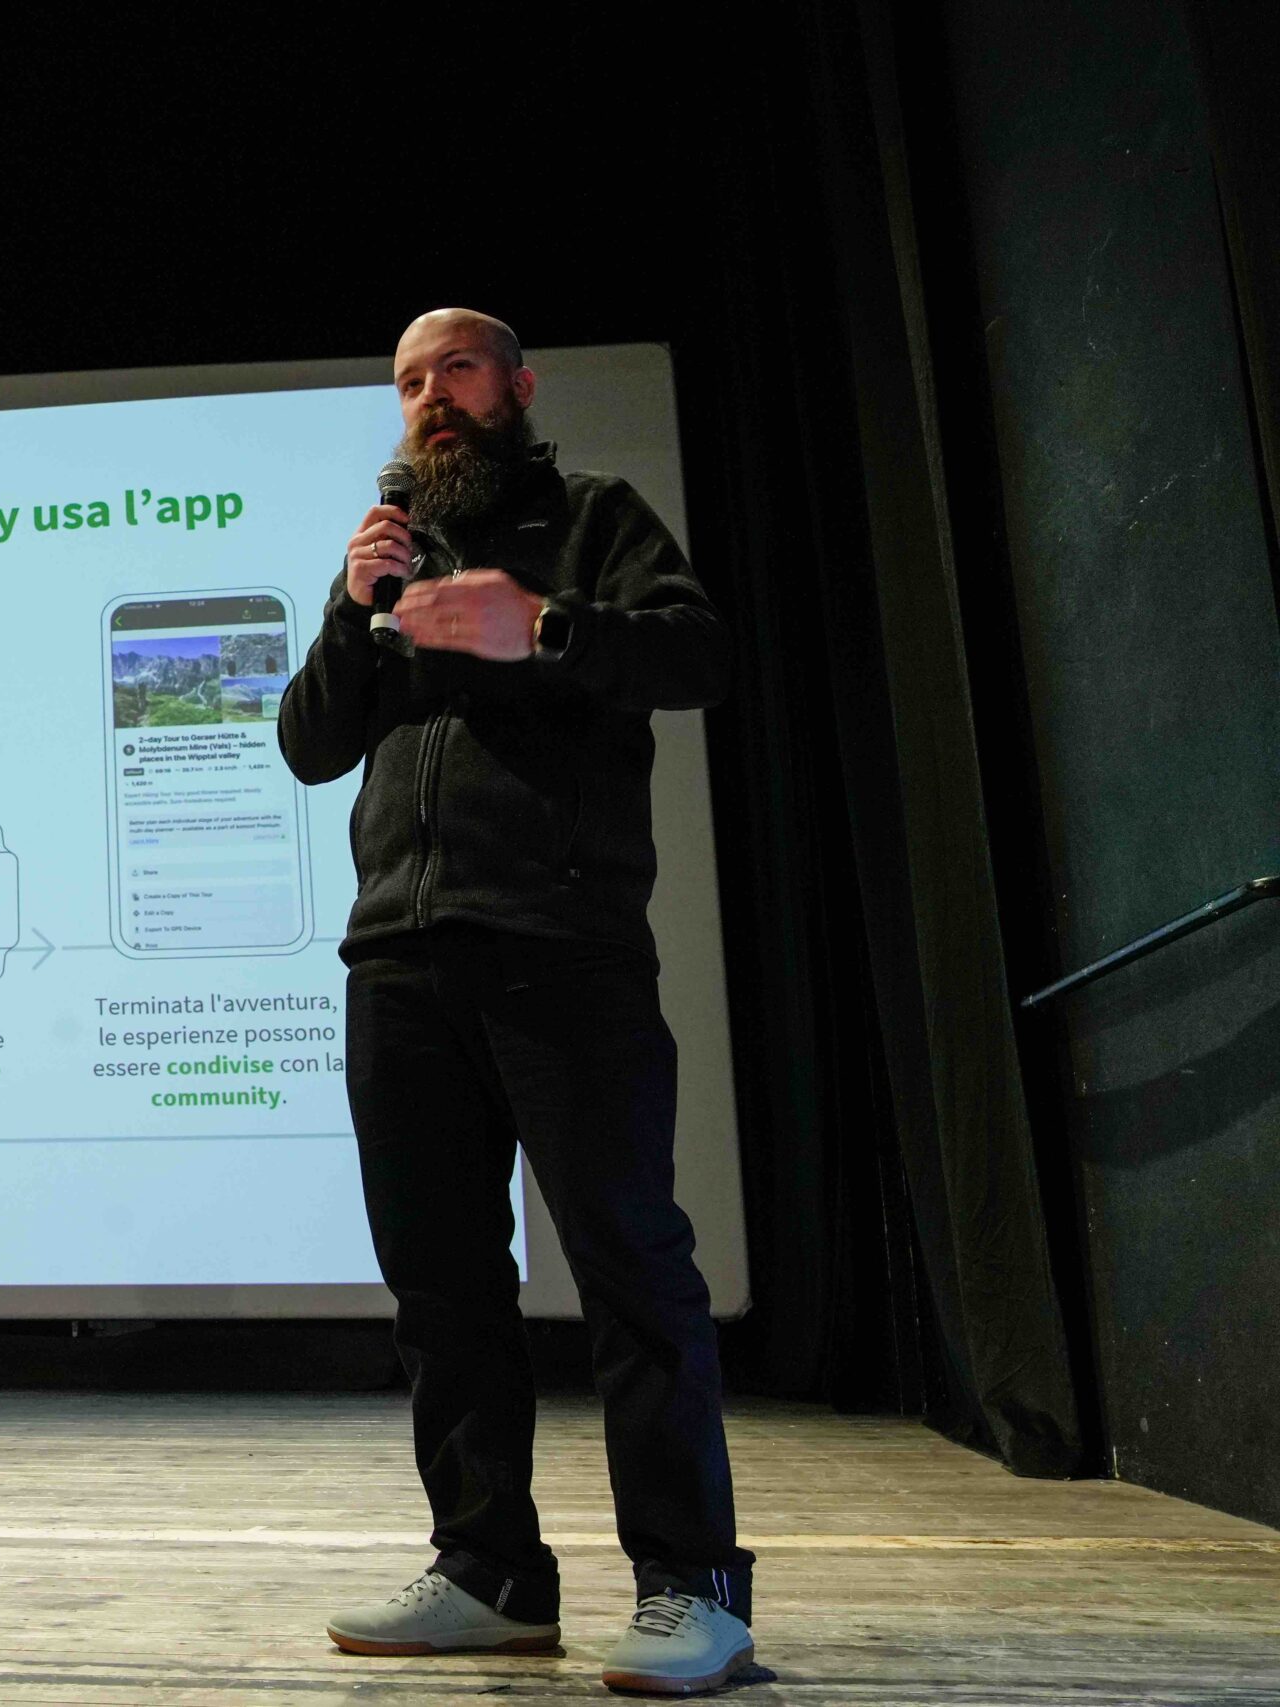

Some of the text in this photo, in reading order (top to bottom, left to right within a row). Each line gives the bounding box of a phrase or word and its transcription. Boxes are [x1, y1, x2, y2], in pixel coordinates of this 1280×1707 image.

[34, 502, 110, 531] usa
[164, 735, 180, 743] Tour
[139, 756, 164, 764] places
[188, 753, 217, 761] Wipptal
[219, 752, 240, 760] valley
[95, 993, 337, 1015] Terminata l'avventura,
[100, 1026, 335, 1050] le esperienze possono
[94, 1053, 343, 1076] essere condivise con la
[152, 1086, 286, 1109] community.
